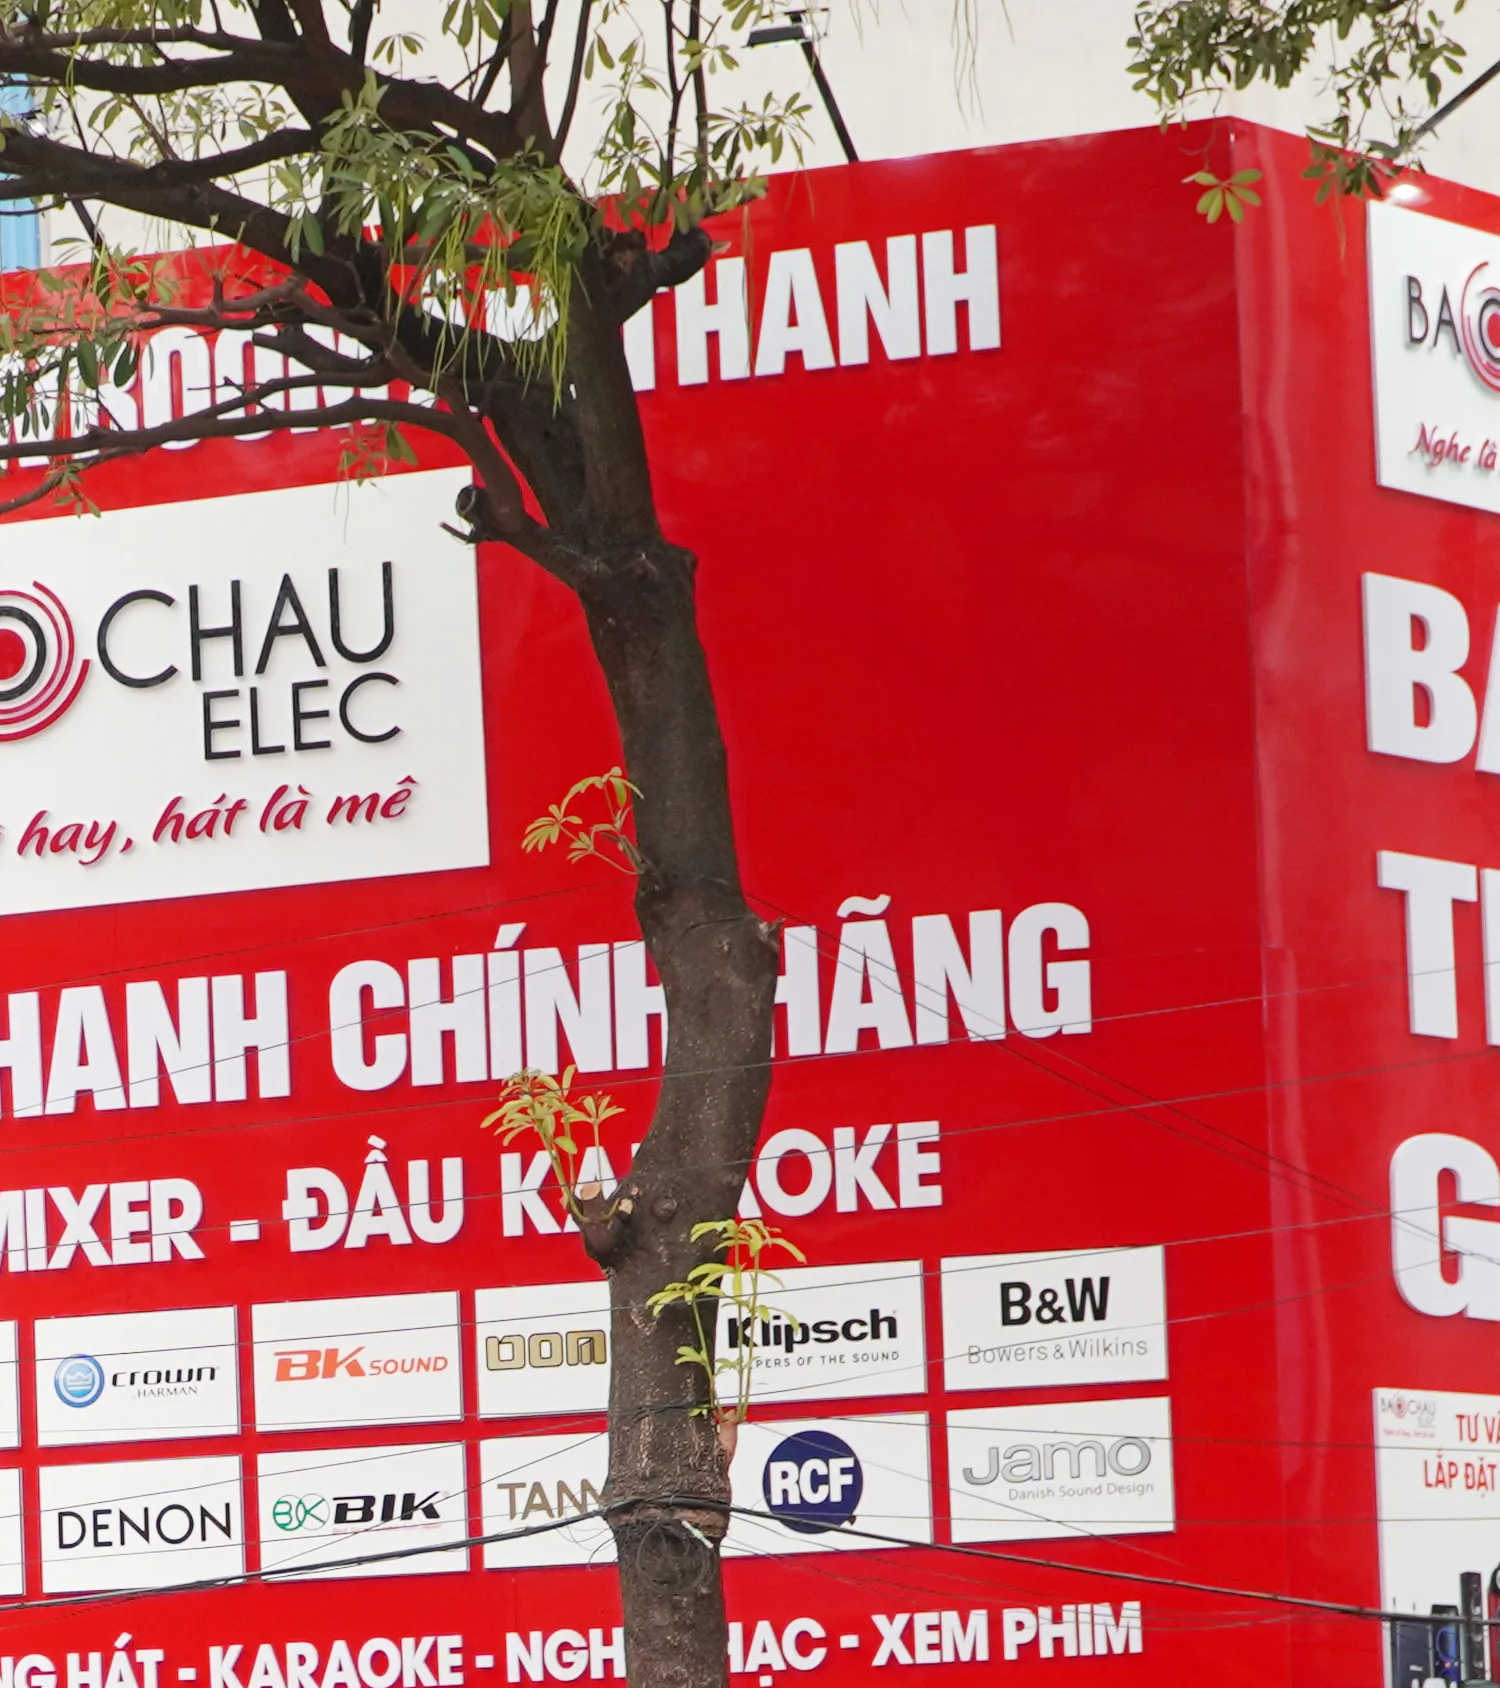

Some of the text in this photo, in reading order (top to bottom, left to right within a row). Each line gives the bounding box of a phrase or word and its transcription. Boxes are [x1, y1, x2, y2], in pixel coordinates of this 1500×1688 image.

[204, 672, 402, 761] ELEC
[152, 793, 249, 843] hát
[258, 784, 313, 834] là
[326, 775, 420, 825] mê
[329, 923, 666, 1091] CHÍNH
[283, 1133, 465, 1254] ĐẦU
[499, 1118, 943, 1240] KAOKE
[1000, 1276, 1110, 1328] B&W
[727, 1308, 898, 1353] Klipsch
[966, 1342, 1049, 1365] Bowers
[1068, 1337, 1148, 1359] Wilkins
[273, 1346, 448, 1382] BK SOUND
[1456, 1413, 1480, 1443] TƯ
[769, 1458, 855, 1505] RCF
[1008, 1487, 1054, 1502] Danish
[1058, 1485, 1097, 1499] Sound
[1423, 1449, 1459, 1491] LẮP
[1464, 1458, 1498, 1499] ĐẶT
[58, 1501, 231, 1550] DENON
[333, 1491, 441, 1524] BIK
[506, 1627, 628, 1684] NGH
[871, 1609, 988, 1668] XEM
[1004, 1600, 1144, 1661] PHIM
